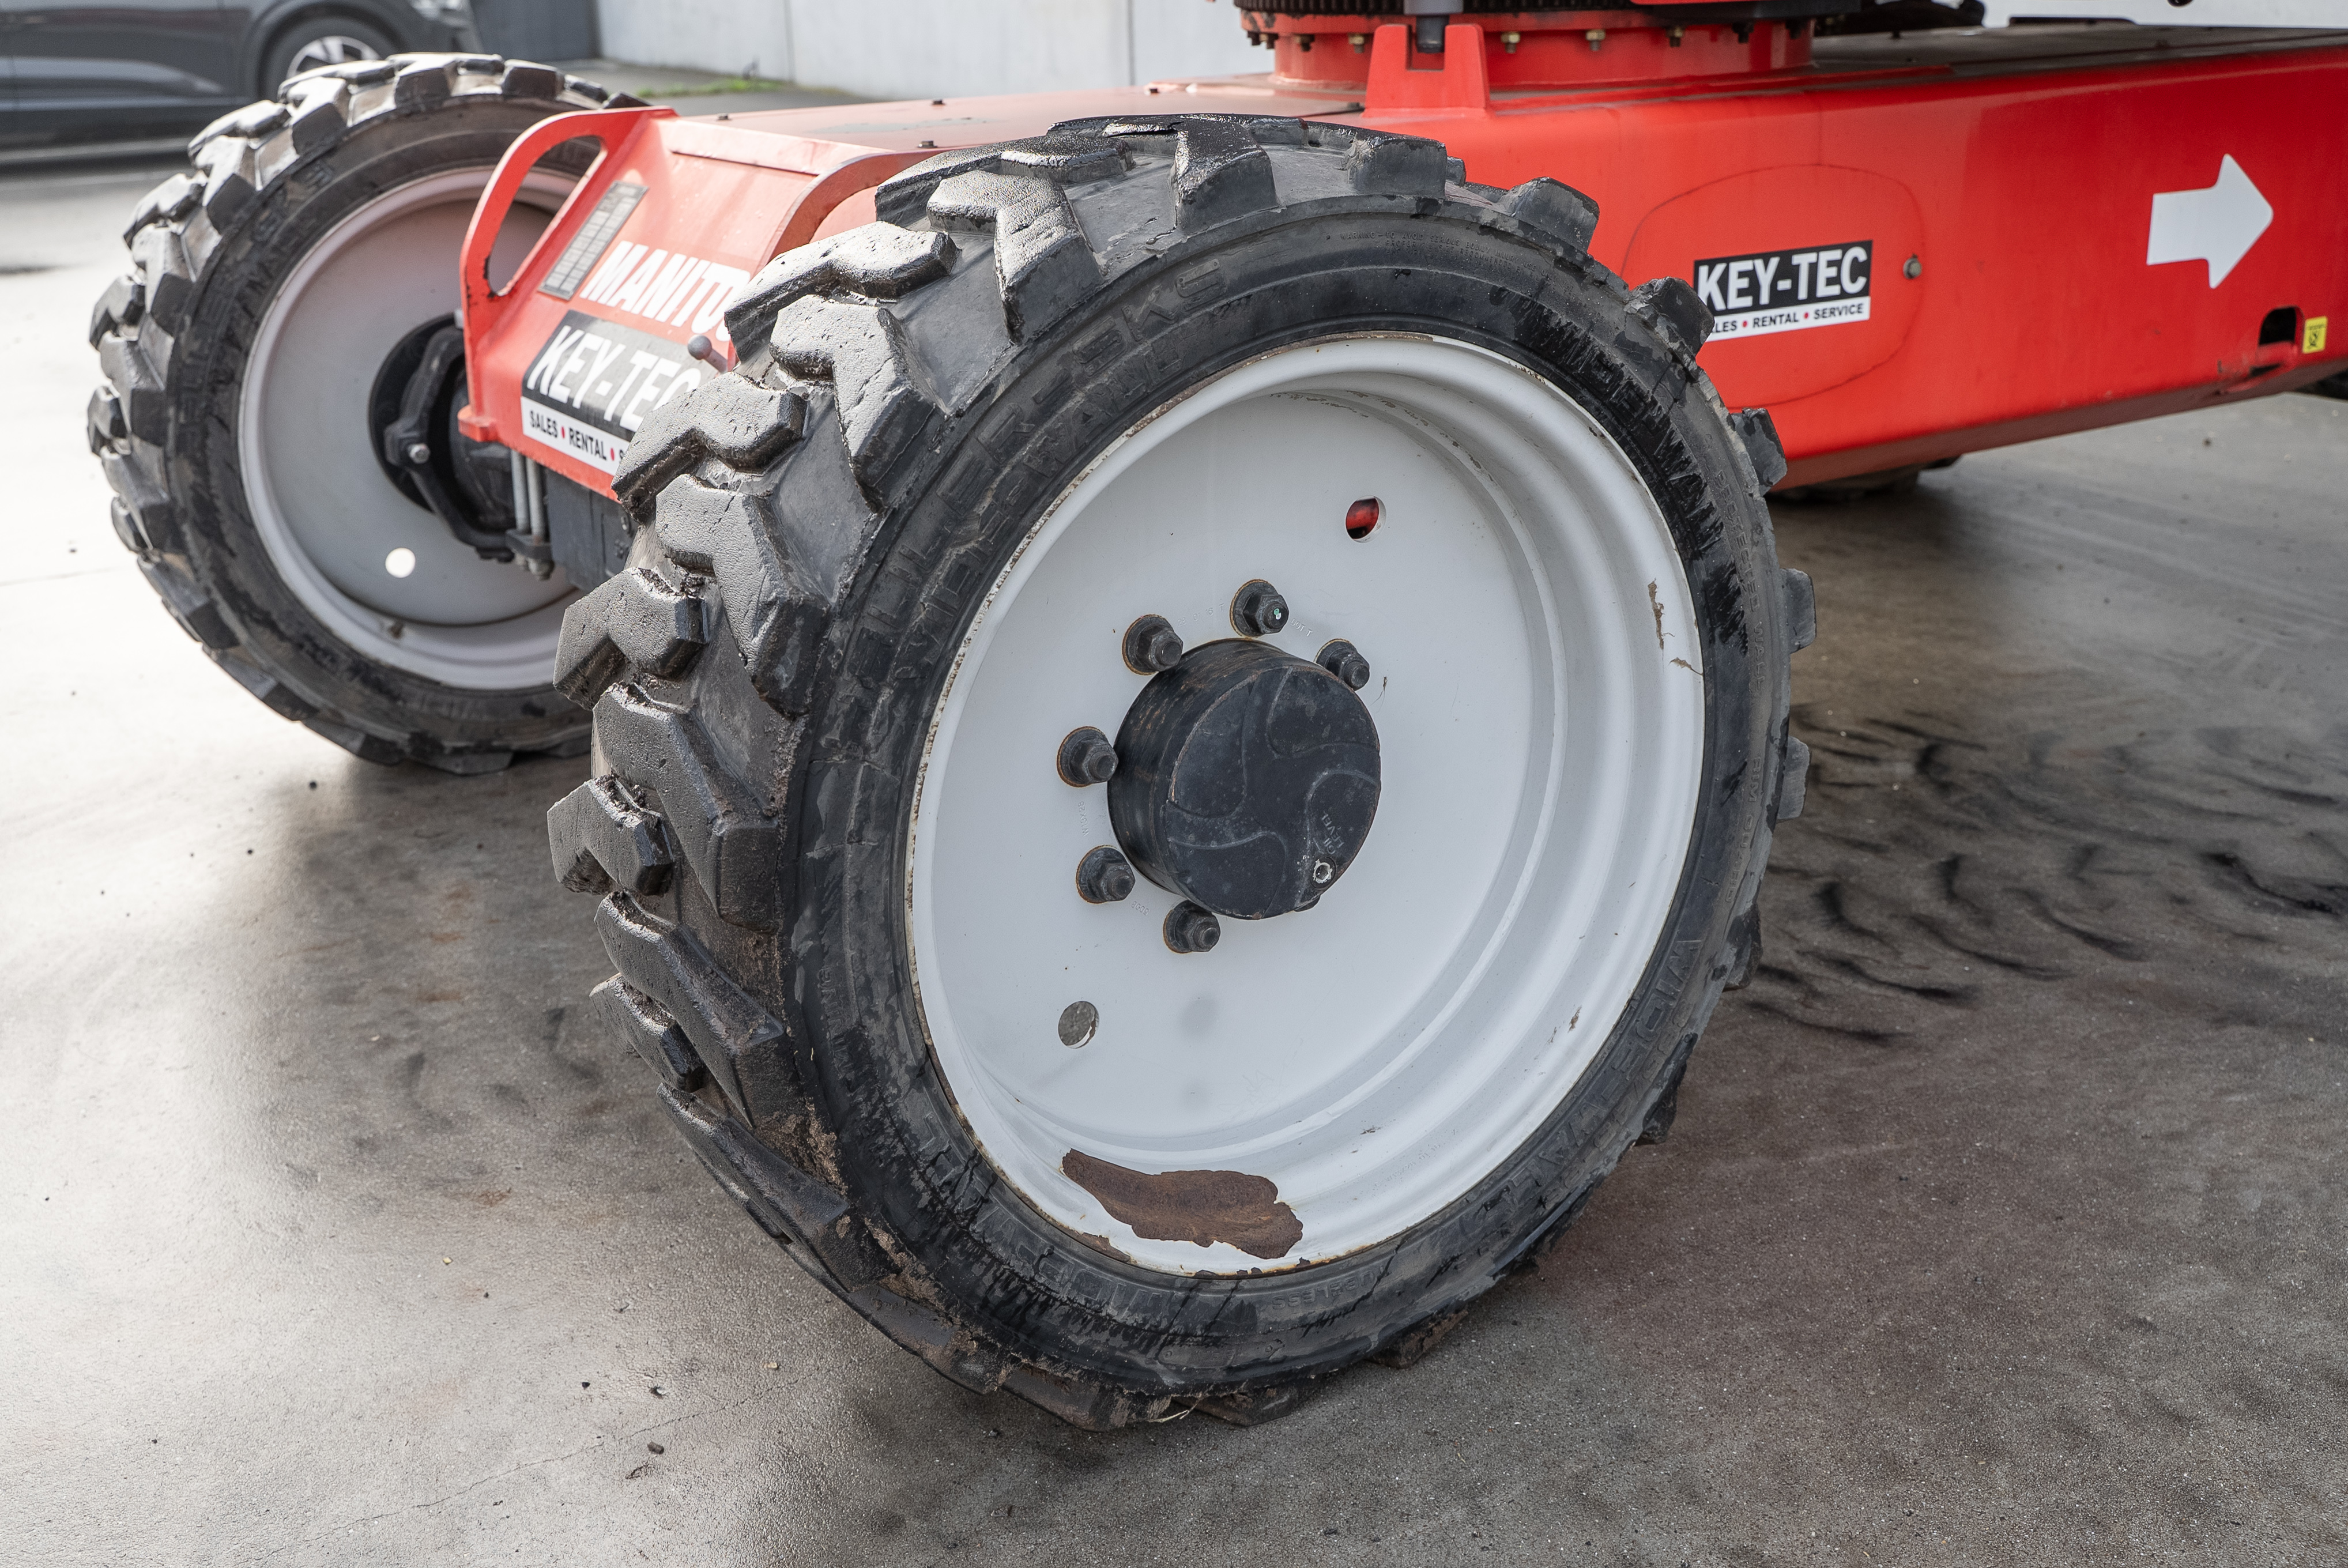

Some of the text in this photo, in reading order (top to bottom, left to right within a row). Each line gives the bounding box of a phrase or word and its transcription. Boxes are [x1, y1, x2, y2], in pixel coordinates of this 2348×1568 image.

[1697, 246, 1868, 311] KEY-TEC
[1711, 303, 1864, 334] LES RENTAL SERVICE
[529, 410, 559, 439] SALES
[568, 427, 608, 461] RENTAL
